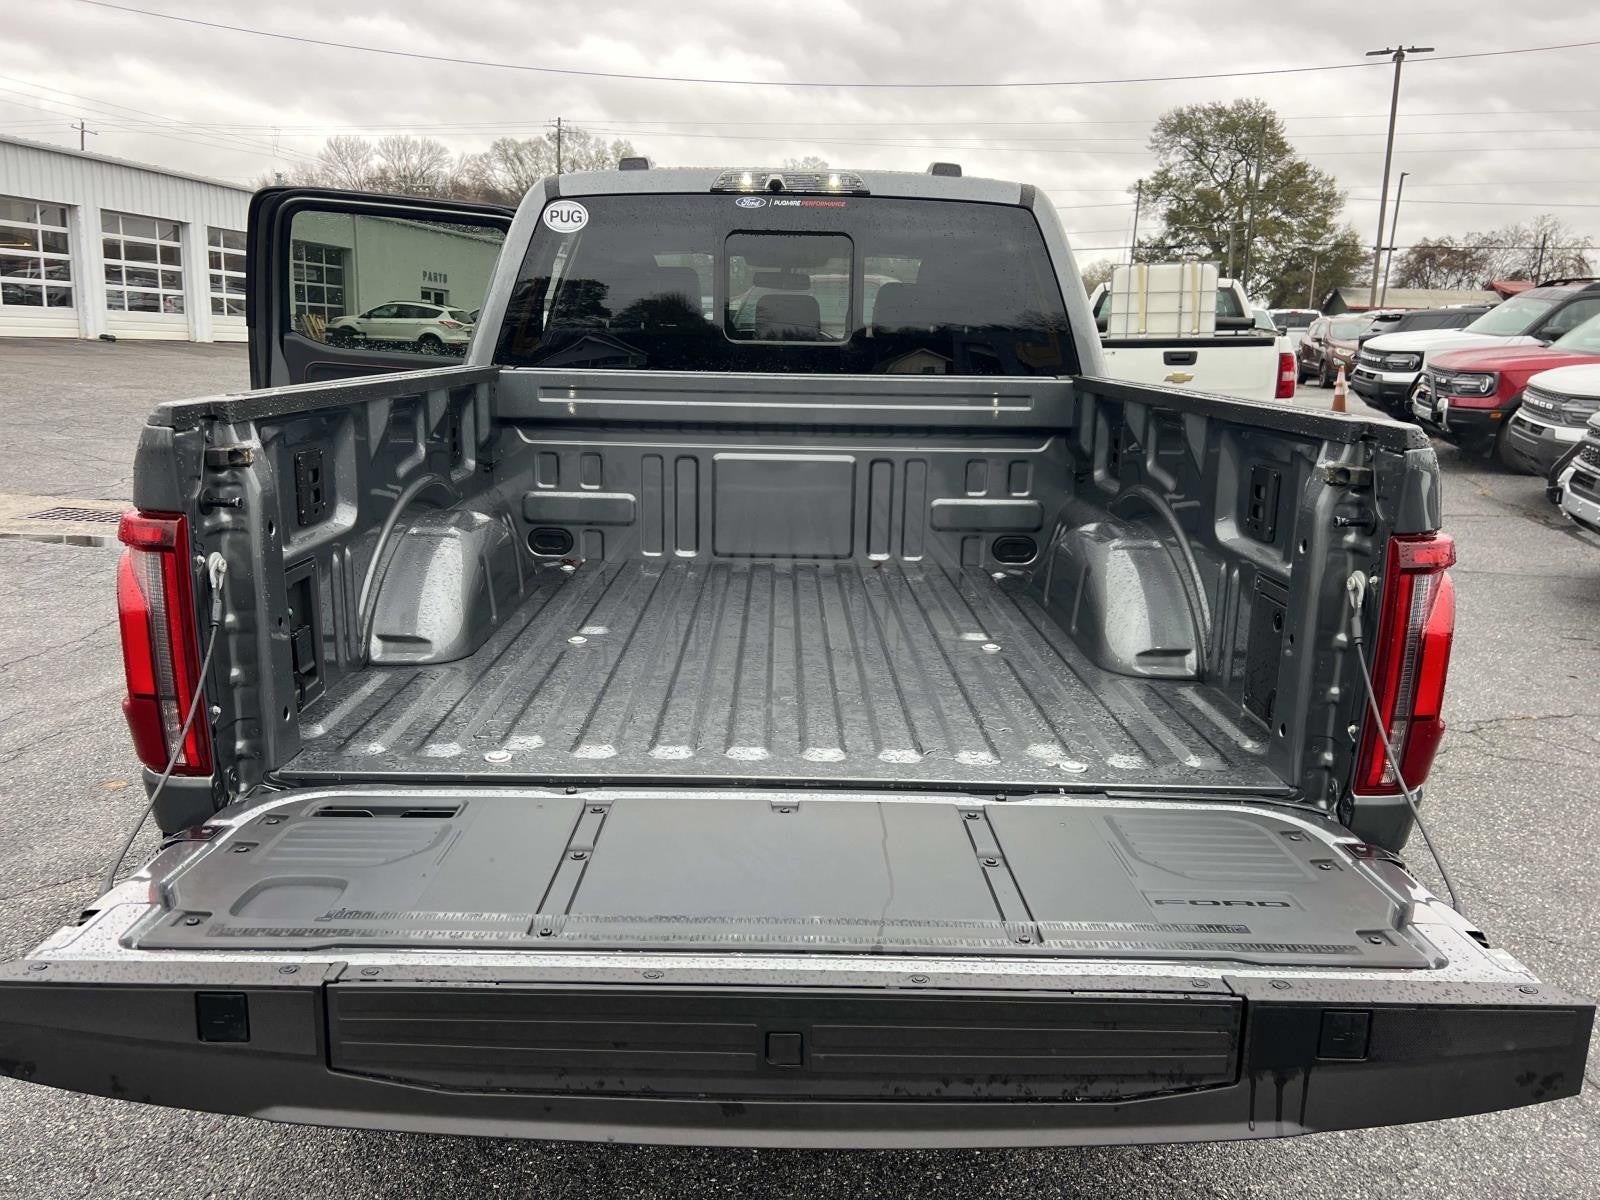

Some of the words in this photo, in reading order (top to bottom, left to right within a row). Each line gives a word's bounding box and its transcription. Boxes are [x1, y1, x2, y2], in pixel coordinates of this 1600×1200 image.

[739, 198, 762, 208] Ford
[801, 200, 847, 208] PERFORMANCE
[550, 210, 582, 223] PUG
[1154, 899, 1291, 908] FORD
